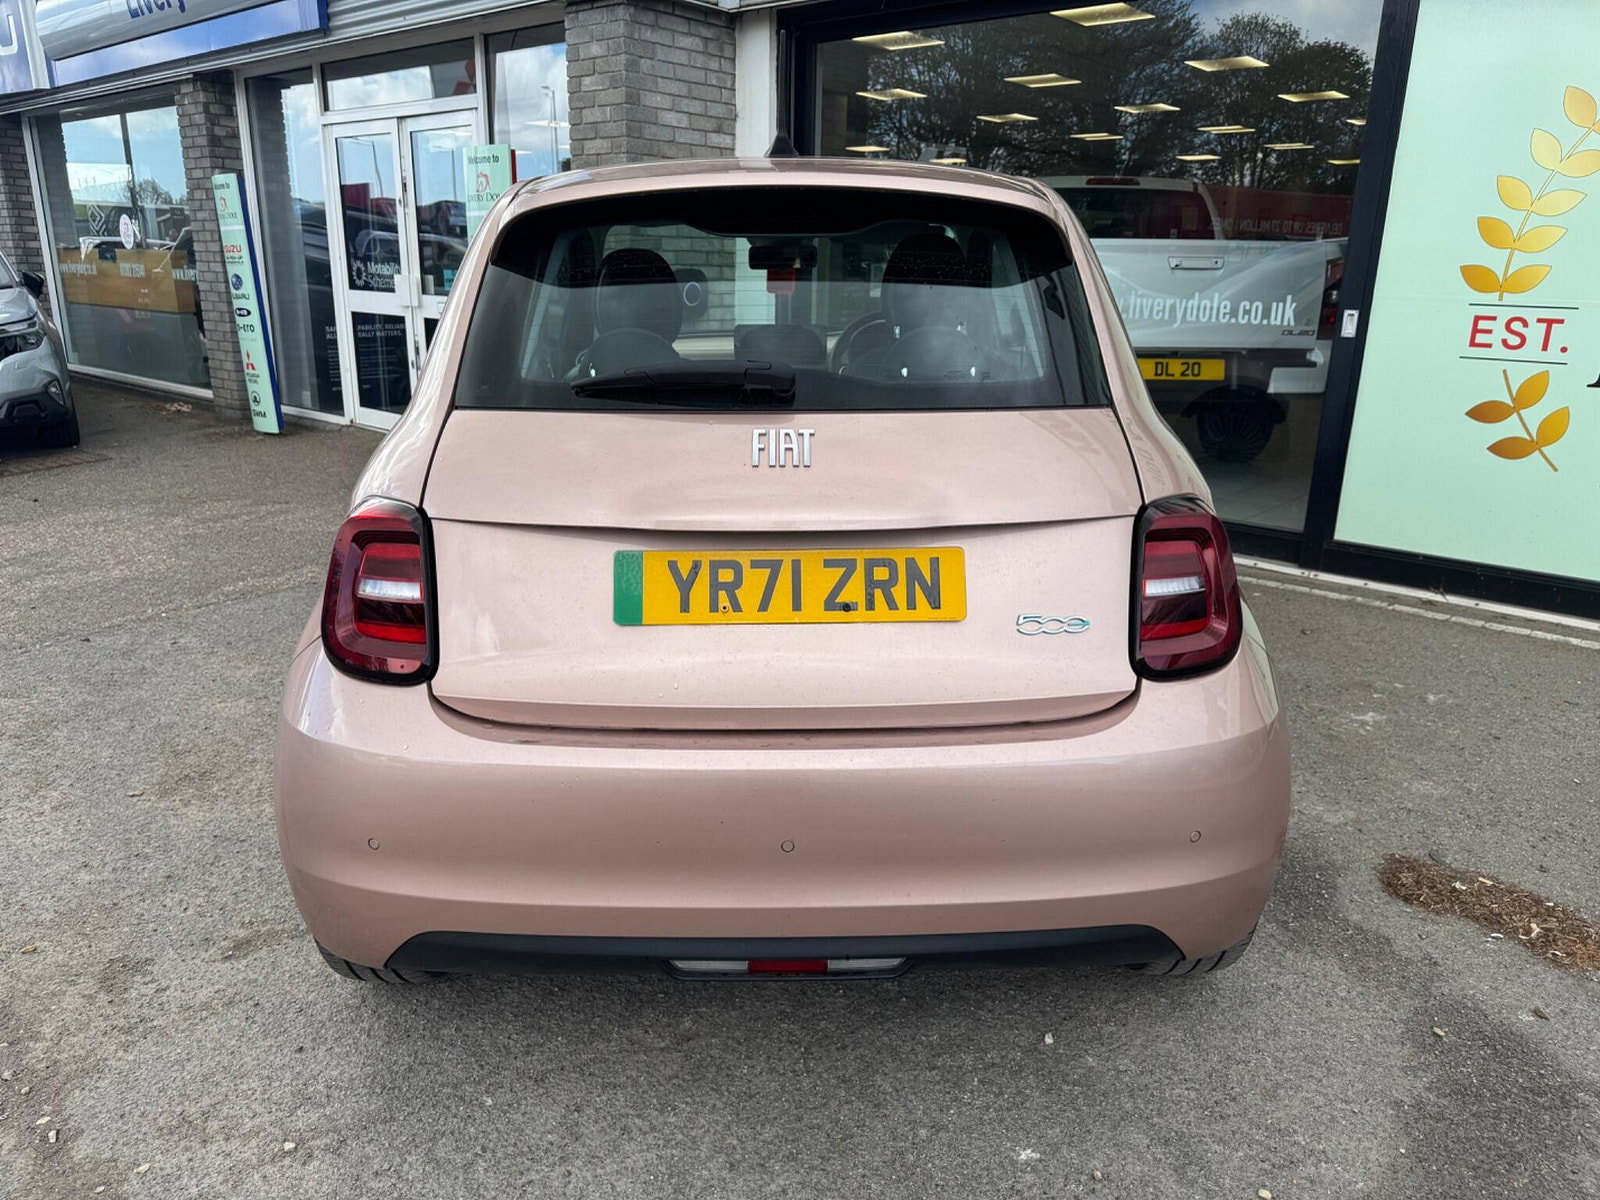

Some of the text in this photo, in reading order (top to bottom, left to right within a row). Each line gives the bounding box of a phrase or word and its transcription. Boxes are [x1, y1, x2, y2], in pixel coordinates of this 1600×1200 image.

[492, 153, 500, 163] to
[1468, 315, 1568, 353] EST.
[1154, 361, 1201, 378] DL 20
[751, 428, 815, 468] FIAT
[667, 556, 940, 614] YR71 ZRN
